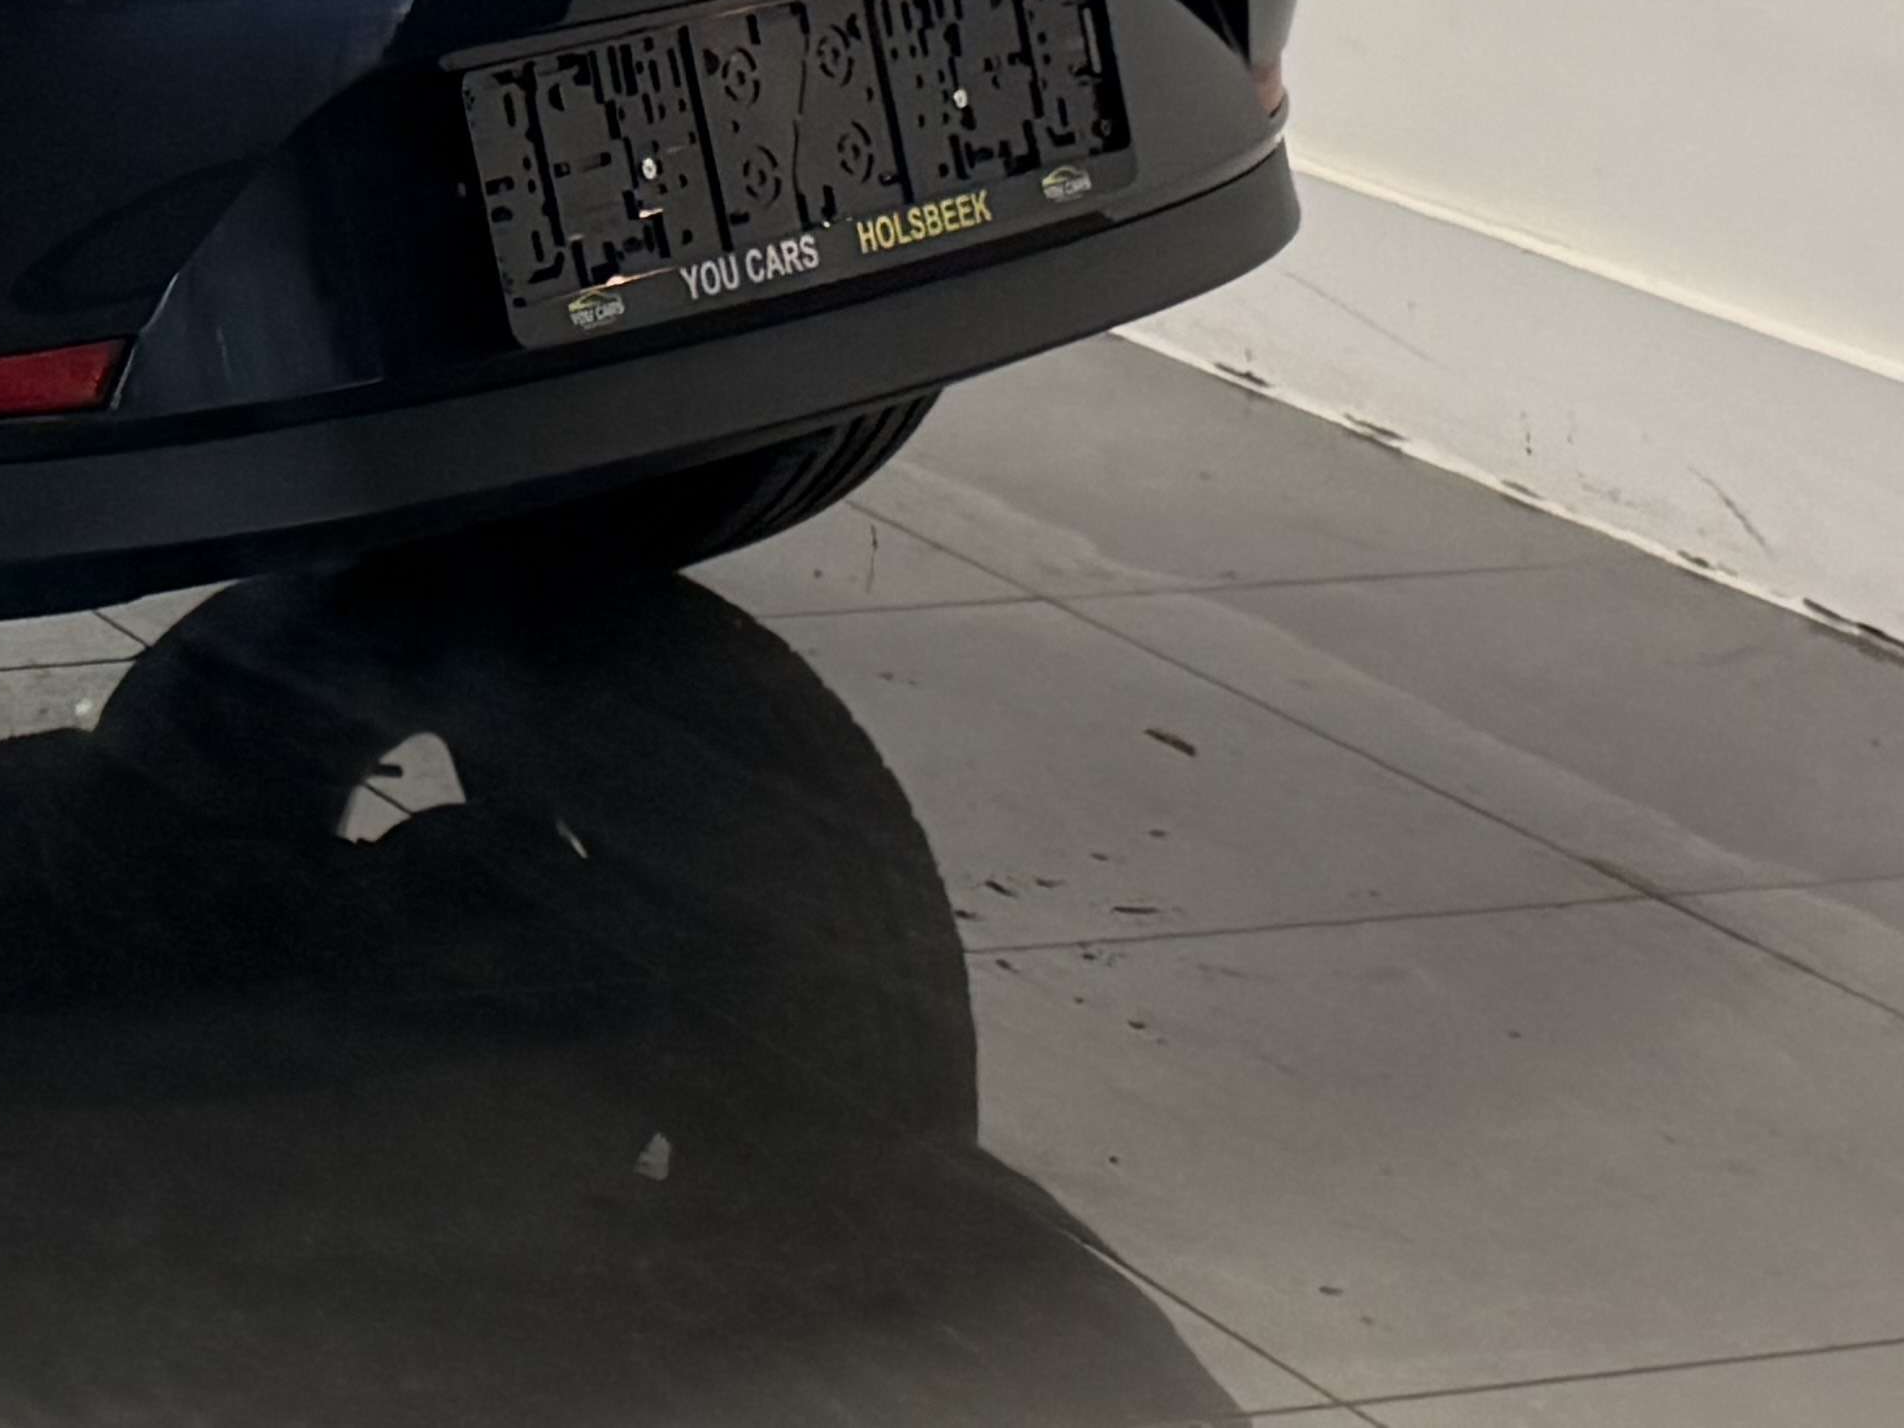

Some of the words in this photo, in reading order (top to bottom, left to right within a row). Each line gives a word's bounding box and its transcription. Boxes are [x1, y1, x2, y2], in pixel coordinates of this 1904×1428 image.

[680, 258, 739, 300] YOU
[745, 235, 820, 284] CARS
[856, 189, 992, 254] HOLSBEEK
